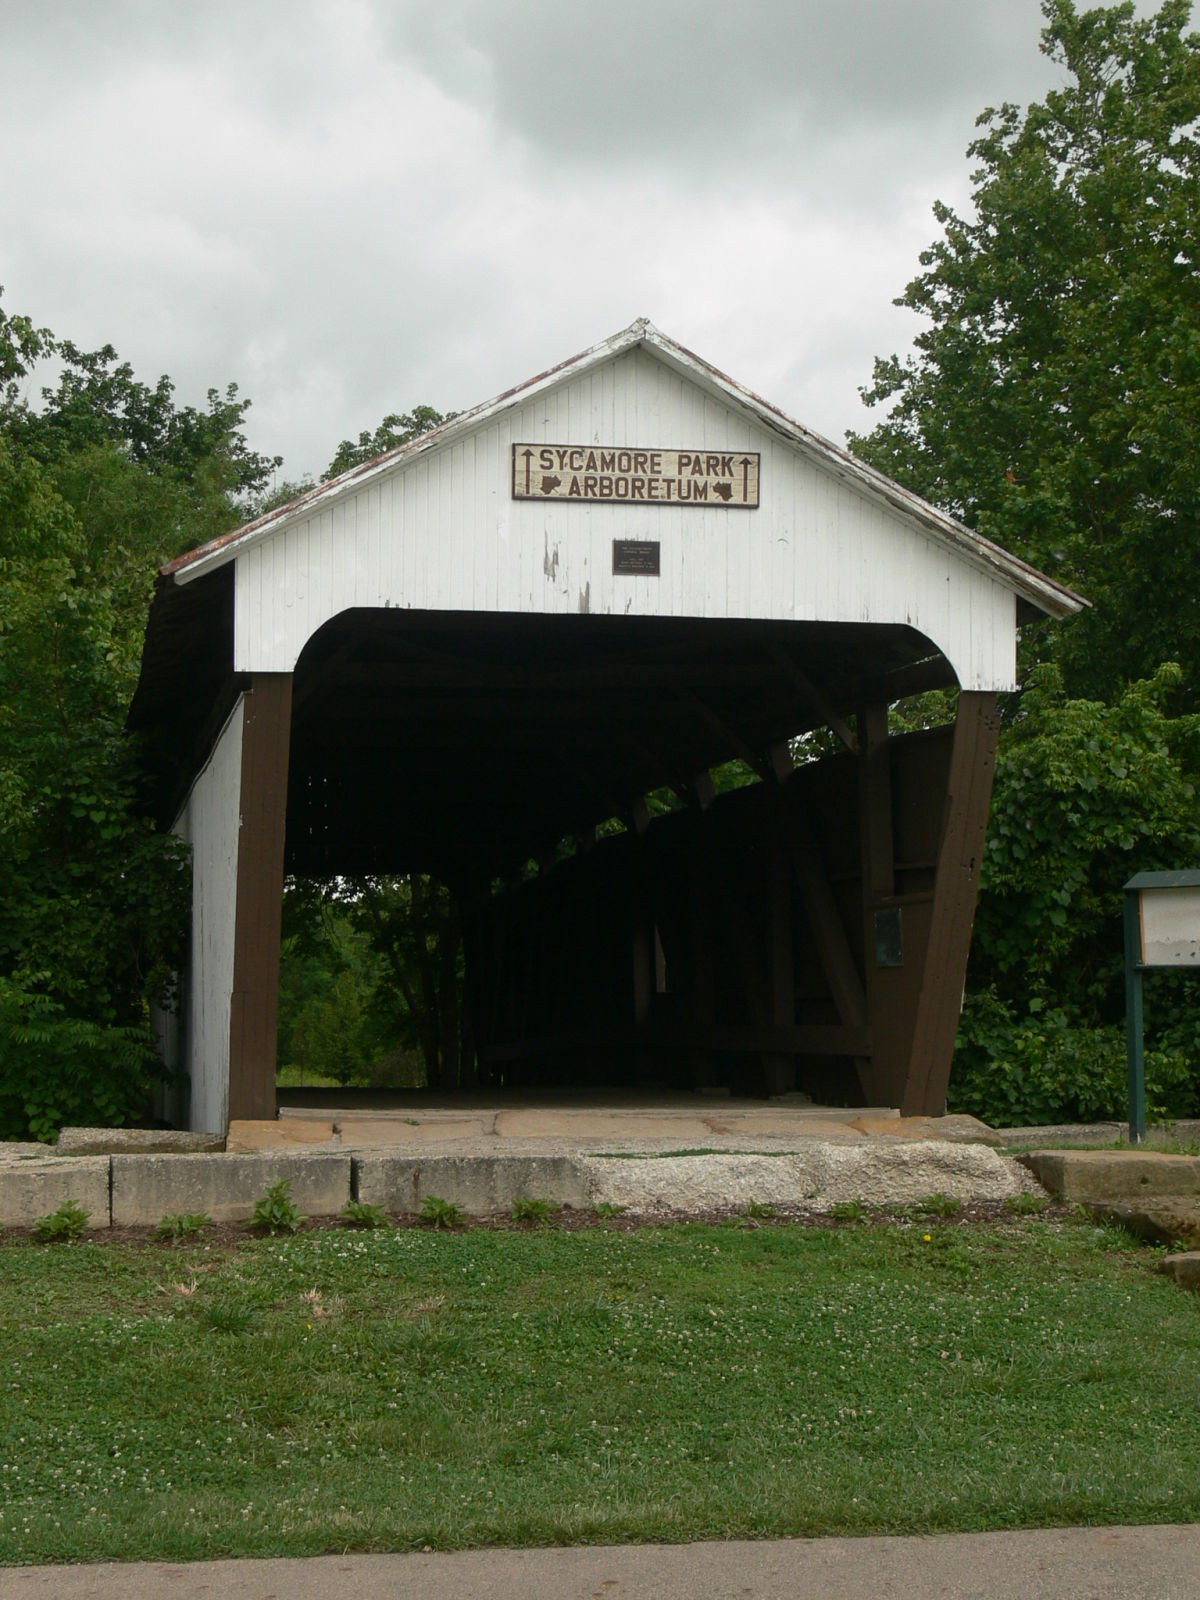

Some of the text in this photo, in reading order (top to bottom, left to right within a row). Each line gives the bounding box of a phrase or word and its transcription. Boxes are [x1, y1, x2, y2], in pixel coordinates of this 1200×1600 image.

[539, 449, 735, 477] SYCAMORE PARK
[568, 475, 708, 501] ARBORETUM
